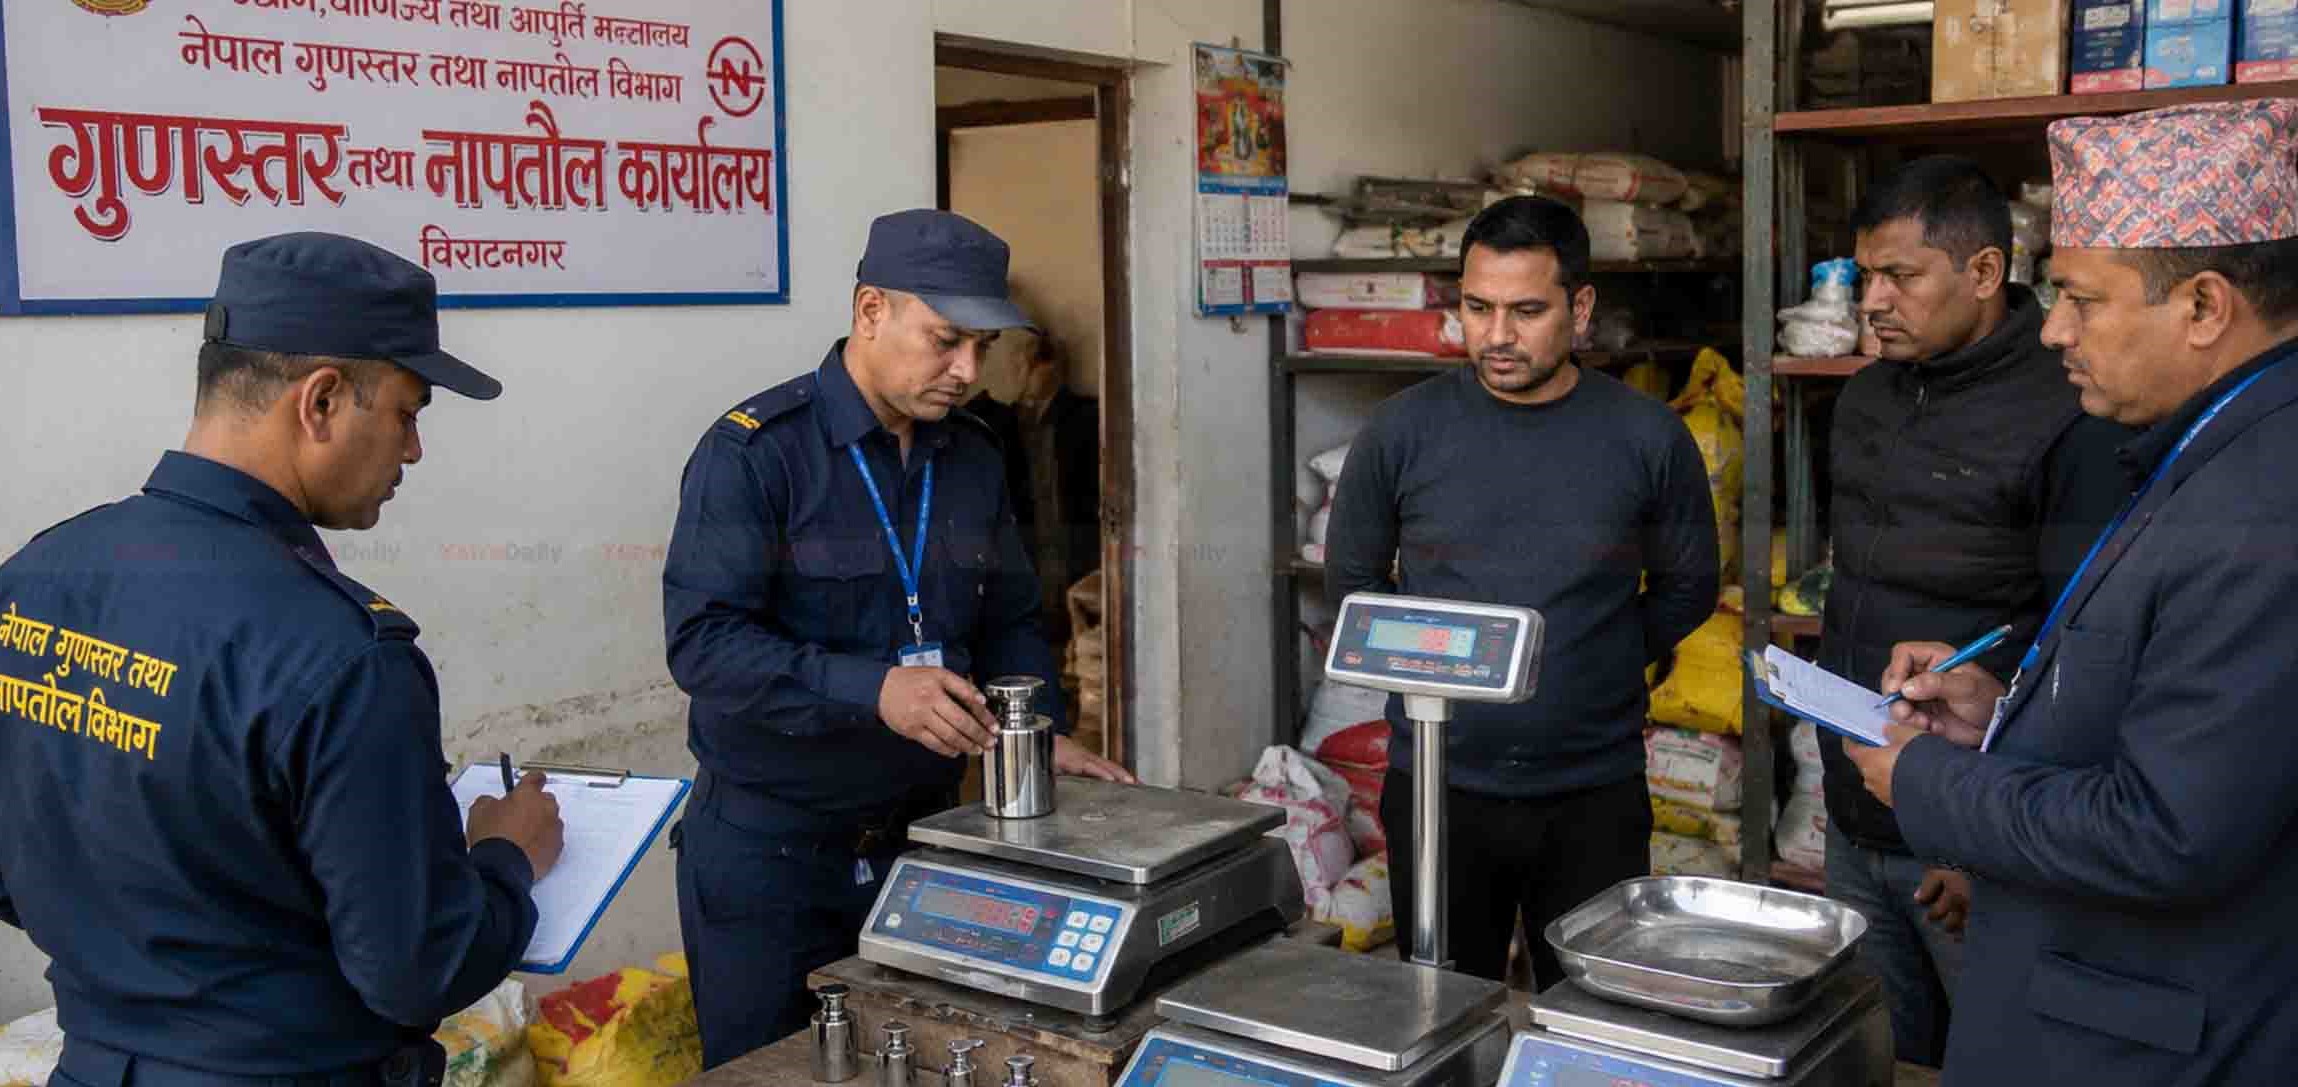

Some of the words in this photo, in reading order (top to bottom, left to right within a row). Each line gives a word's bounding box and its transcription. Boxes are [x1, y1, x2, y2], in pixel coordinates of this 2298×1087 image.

[179, 15, 284, 74] नेपाल
[294, 43, 420, 91] गुणस्तर
[430, 54, 487, 89] तथा
[606, 57, 683, 102] विभाग
[450, 1, 499, 29] तथा
[36, 106, 348, 240] गुणस्तर
[346, 147, 415, 190] तथा
[422, 99, 608, 209] नापतौल
[616, 115, 773, 213] कार्यालय
[419, 224, 566, 270] विराटनगर
[0, 602, 54, 656] नेपाल
[55, 629, 129, 682] गुणस्तर
[128, 653, 178, 697] तथा
[0, 673, 86, 733] ापतोल
[86, 687, 162, 760] विभाग
